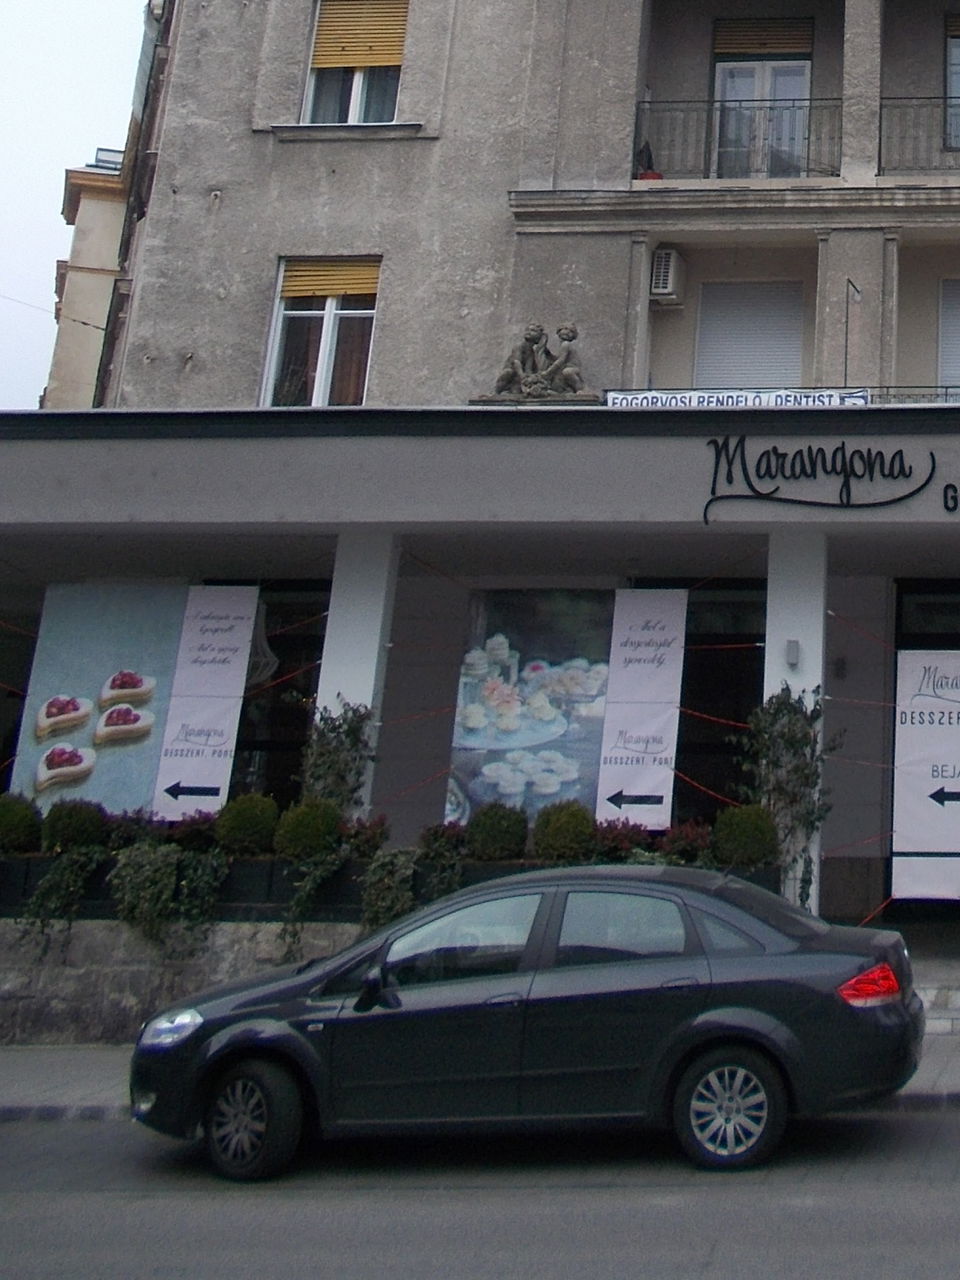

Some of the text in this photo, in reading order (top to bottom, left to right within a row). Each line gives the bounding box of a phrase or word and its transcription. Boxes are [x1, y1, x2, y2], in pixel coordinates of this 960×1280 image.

[612, 395, 692, 406] FOGORVOSI
[774, 393, 834, 406] DENTIST
[704, 434, 932, 516] Marangona
